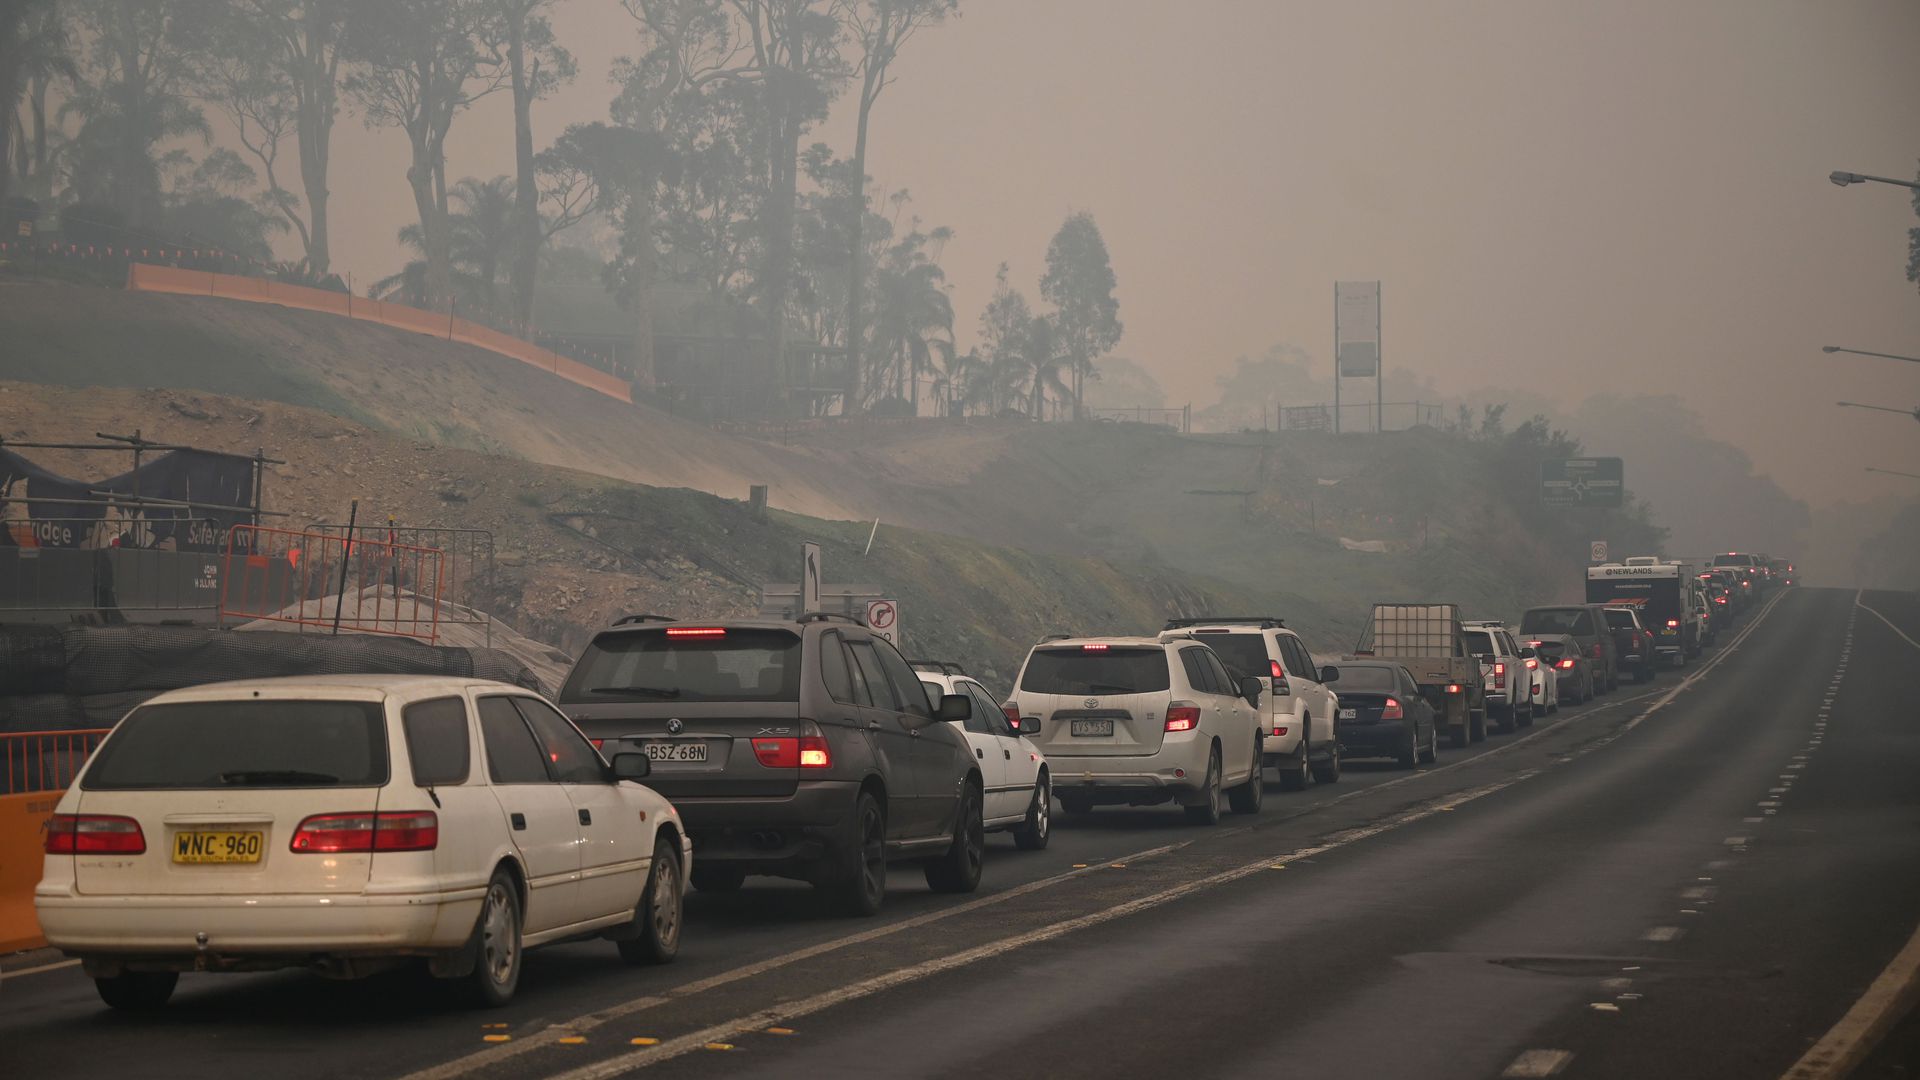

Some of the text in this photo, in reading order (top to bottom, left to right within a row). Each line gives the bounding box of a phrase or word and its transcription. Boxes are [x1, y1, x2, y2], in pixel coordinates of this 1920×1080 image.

[31, 520, 72, 546] ridge
[188, 521, 218, 545] Safer
[1613, 568, 1653, 576] NEWLANDS
[194, 578, 217, 589] HLLAN
[757, 727, 791, 735] X5
